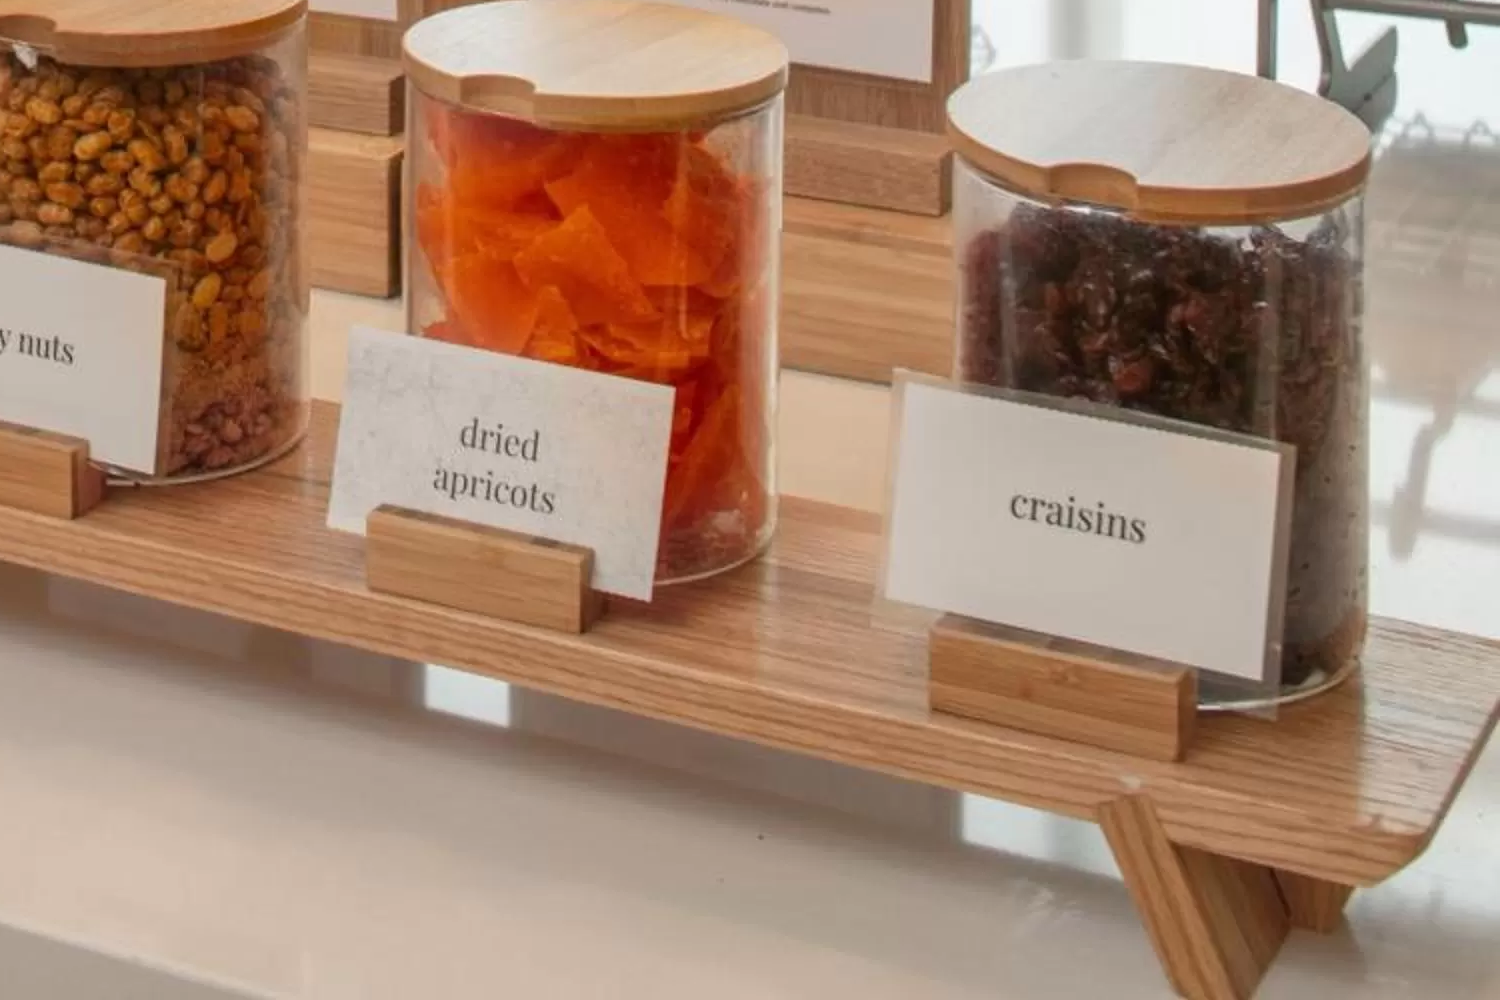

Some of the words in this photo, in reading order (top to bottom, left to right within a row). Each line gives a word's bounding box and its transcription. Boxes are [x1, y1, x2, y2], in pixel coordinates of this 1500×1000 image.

[19, 332, 75, 366] nuts
[460, 416, 541, 463] dried
[433, 467, 556, 515] apricots
[1010, 494, 1146, 544] craisins
